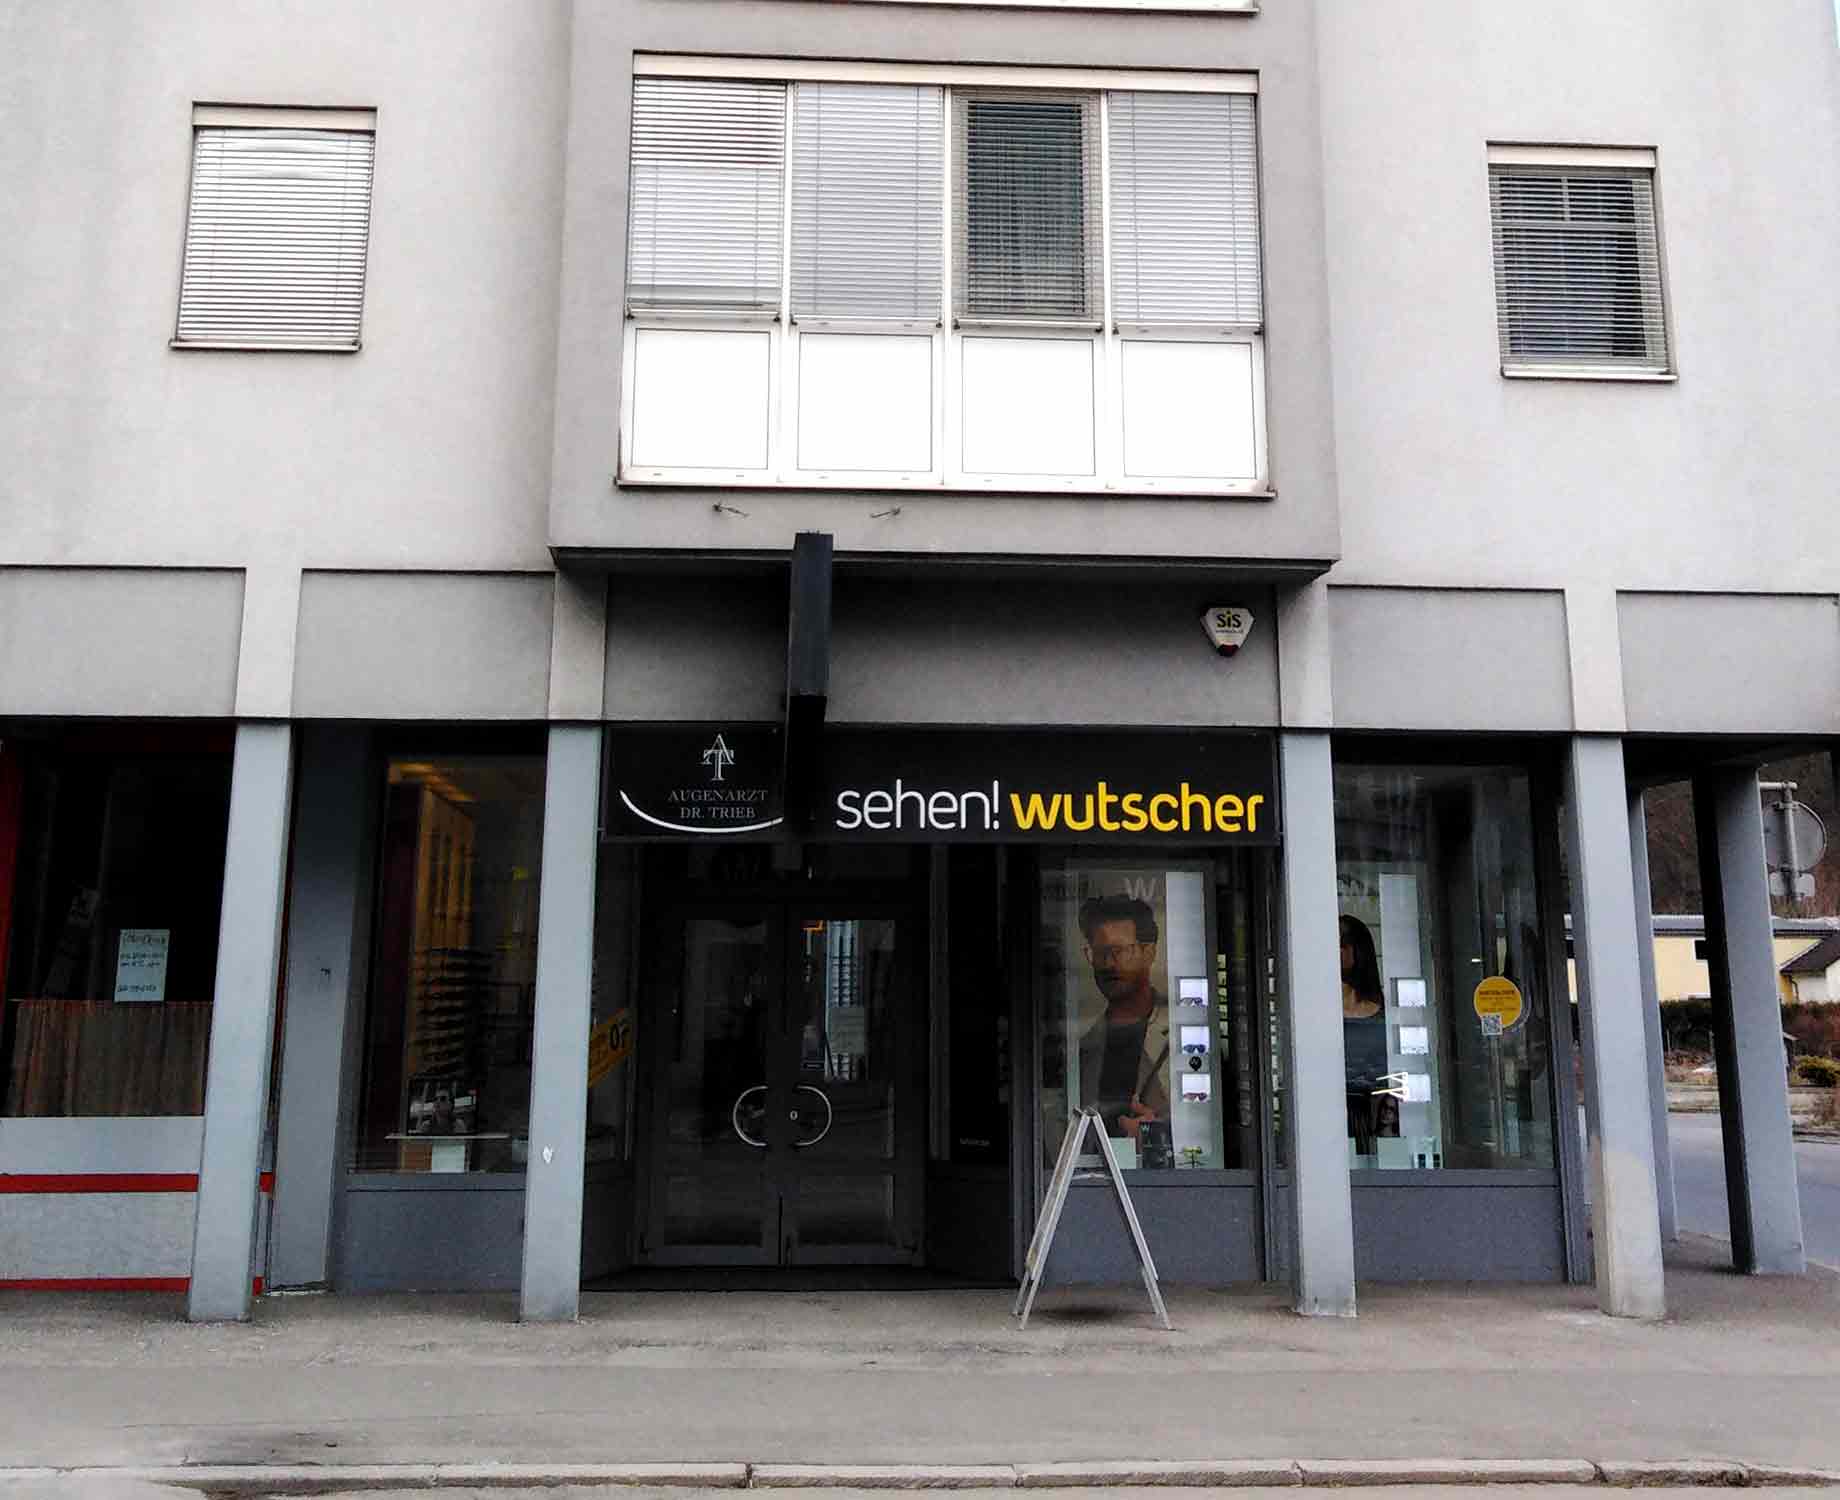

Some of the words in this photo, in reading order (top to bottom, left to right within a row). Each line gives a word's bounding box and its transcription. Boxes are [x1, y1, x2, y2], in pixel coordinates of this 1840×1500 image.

[668, 789, 768, 802] AUGENARZT
[836, 779, 1000, 830] sehen!
[1010, 782, 1264, 832] wutscher
[679, 806, 705, 819] DR.
[708, 806, 756, 819] TRIEB
